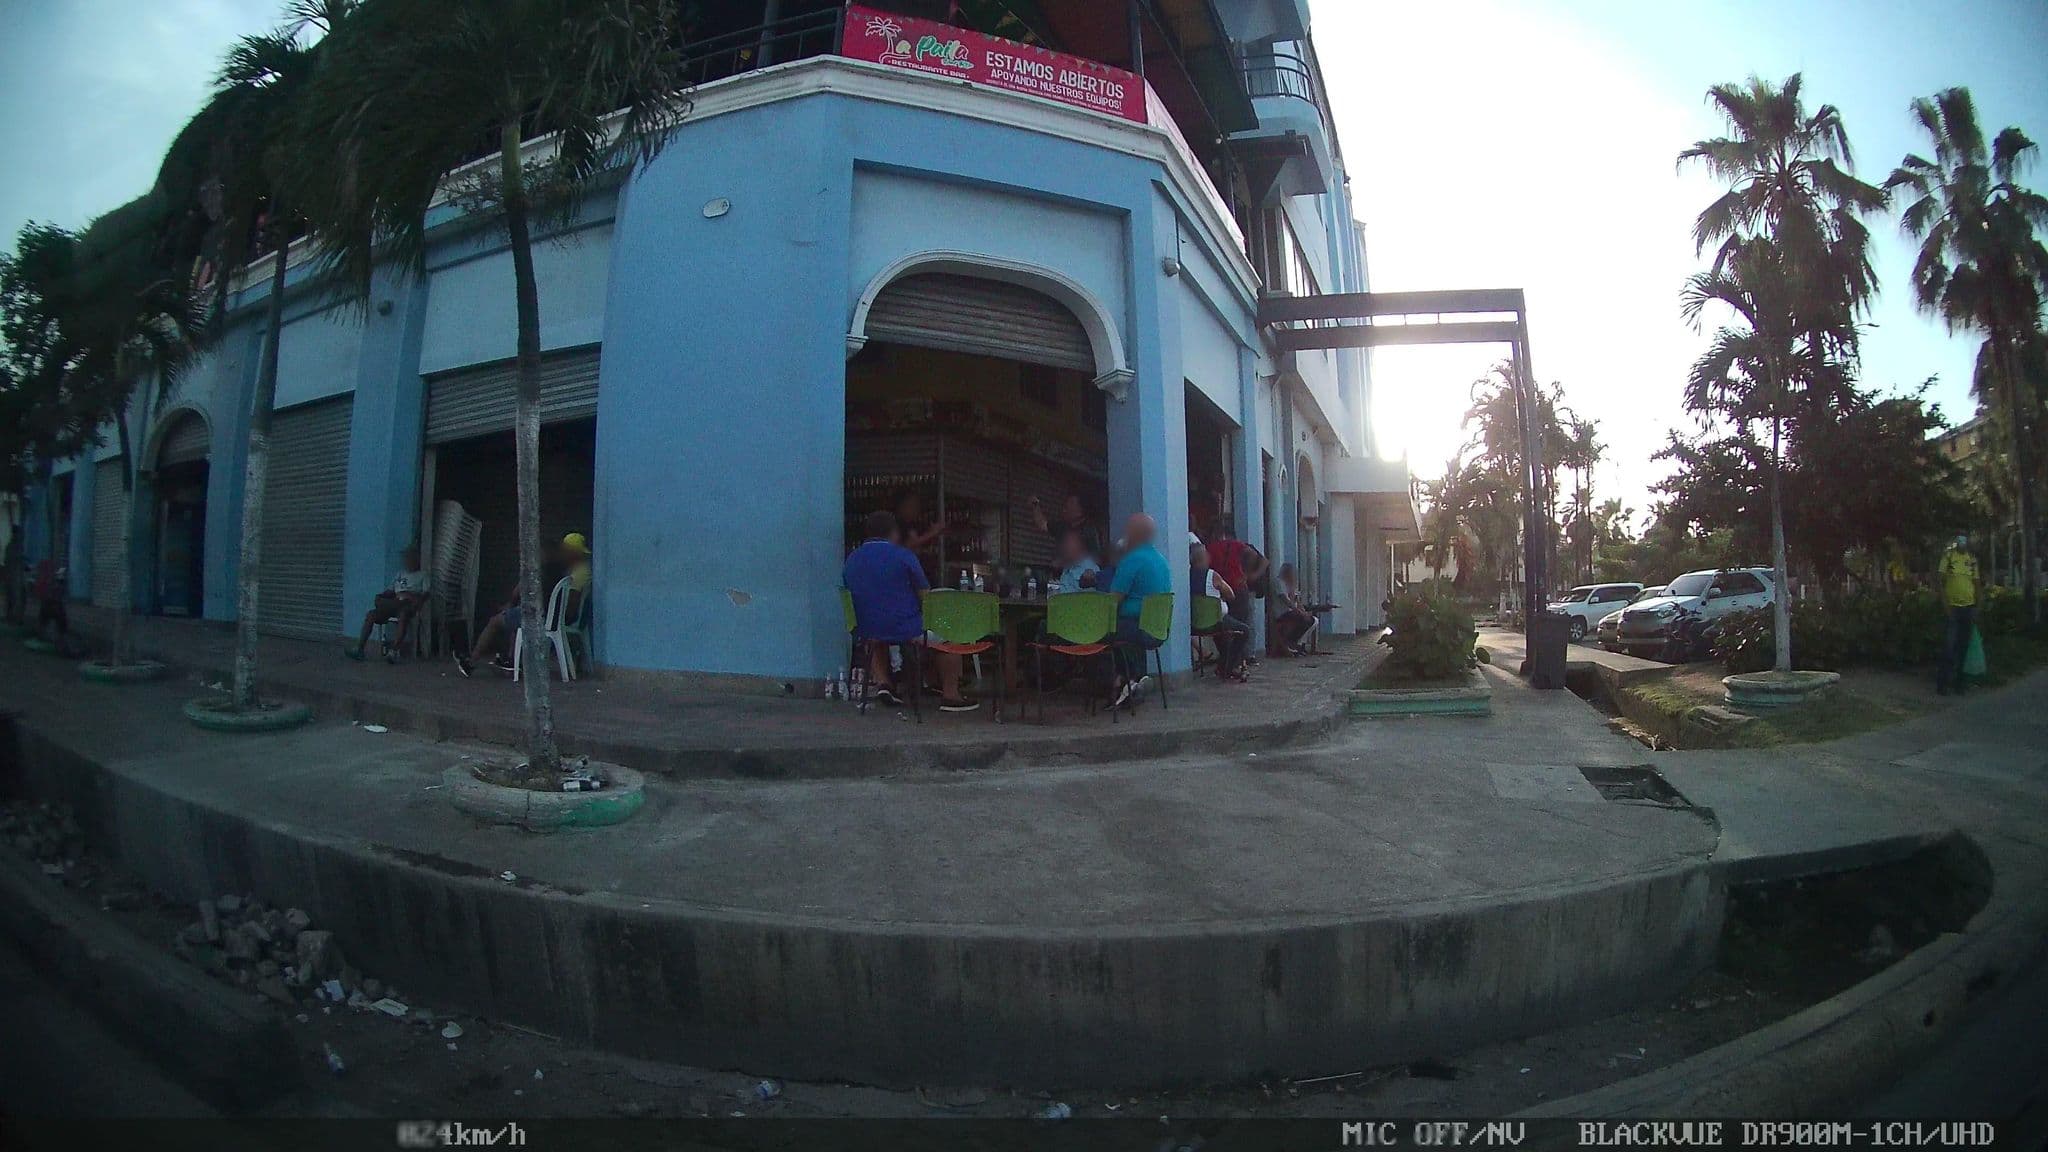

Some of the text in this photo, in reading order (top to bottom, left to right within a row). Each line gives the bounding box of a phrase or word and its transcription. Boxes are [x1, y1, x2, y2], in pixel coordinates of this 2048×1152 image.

[891, 59, 949, 75] RESTAURANTE
[950, 70, 967, 78] BAR
[986, 50, 1054, 80] ESTAMOS
[1060, 69, 1124, 99] ABIERTOS
[991, 68, 1038, 88] APOYANDO
[1040, 80, 1084, 100] NUESTROS
[1086, 91, 1122, 110] EQUIPOS!
